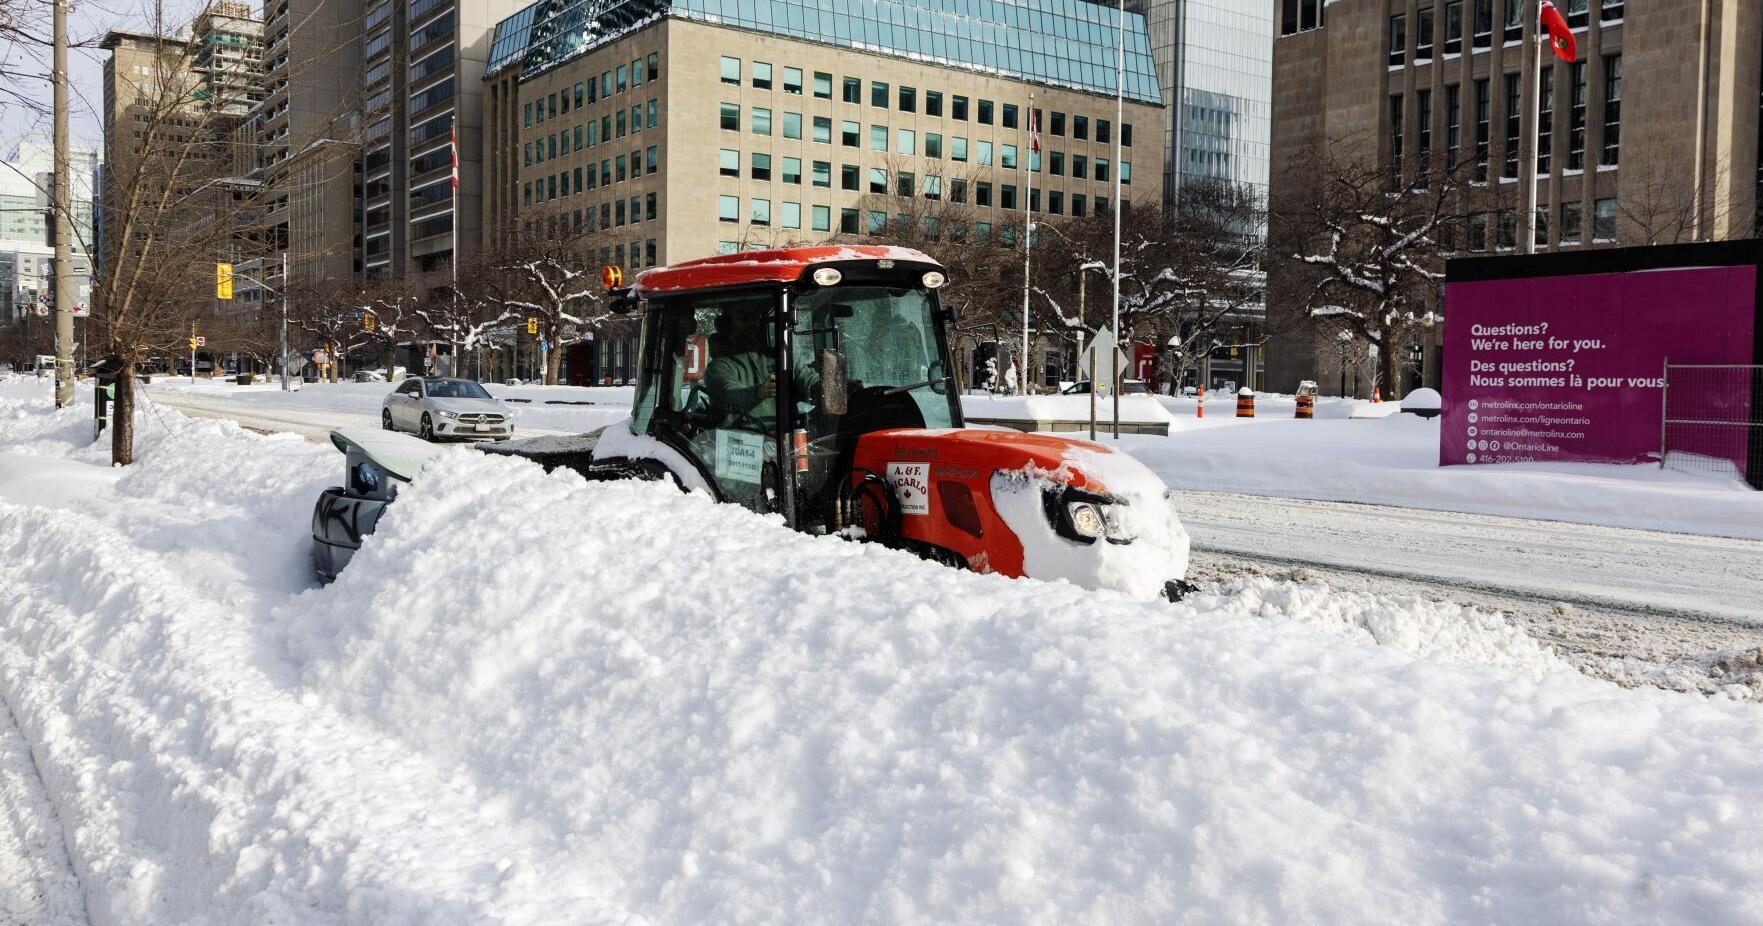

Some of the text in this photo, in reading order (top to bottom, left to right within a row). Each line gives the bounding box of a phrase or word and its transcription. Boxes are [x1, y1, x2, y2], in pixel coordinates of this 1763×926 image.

[1471, 322, 1548, 336] Questions?
[1471, 336, 1606, 353] We're here for you.
[1470, 359, 1575, 375] Des questions?
[1470, 374, 1669, 391] Nous sommes là pour vous.
[1481, 400, 1583, 411] metrolinx.com/ontarioline
[1481, 414, 1591, 426] metrolinx.com/ligneontario
[1480, 428, 1585, 439] ontarioline@metrolinx.com
[1503, 441, 1560, 453] @OntarioLine
[894, 466, 921, 475] A. & F.
[893, 477, 927, 495] ICARLO
